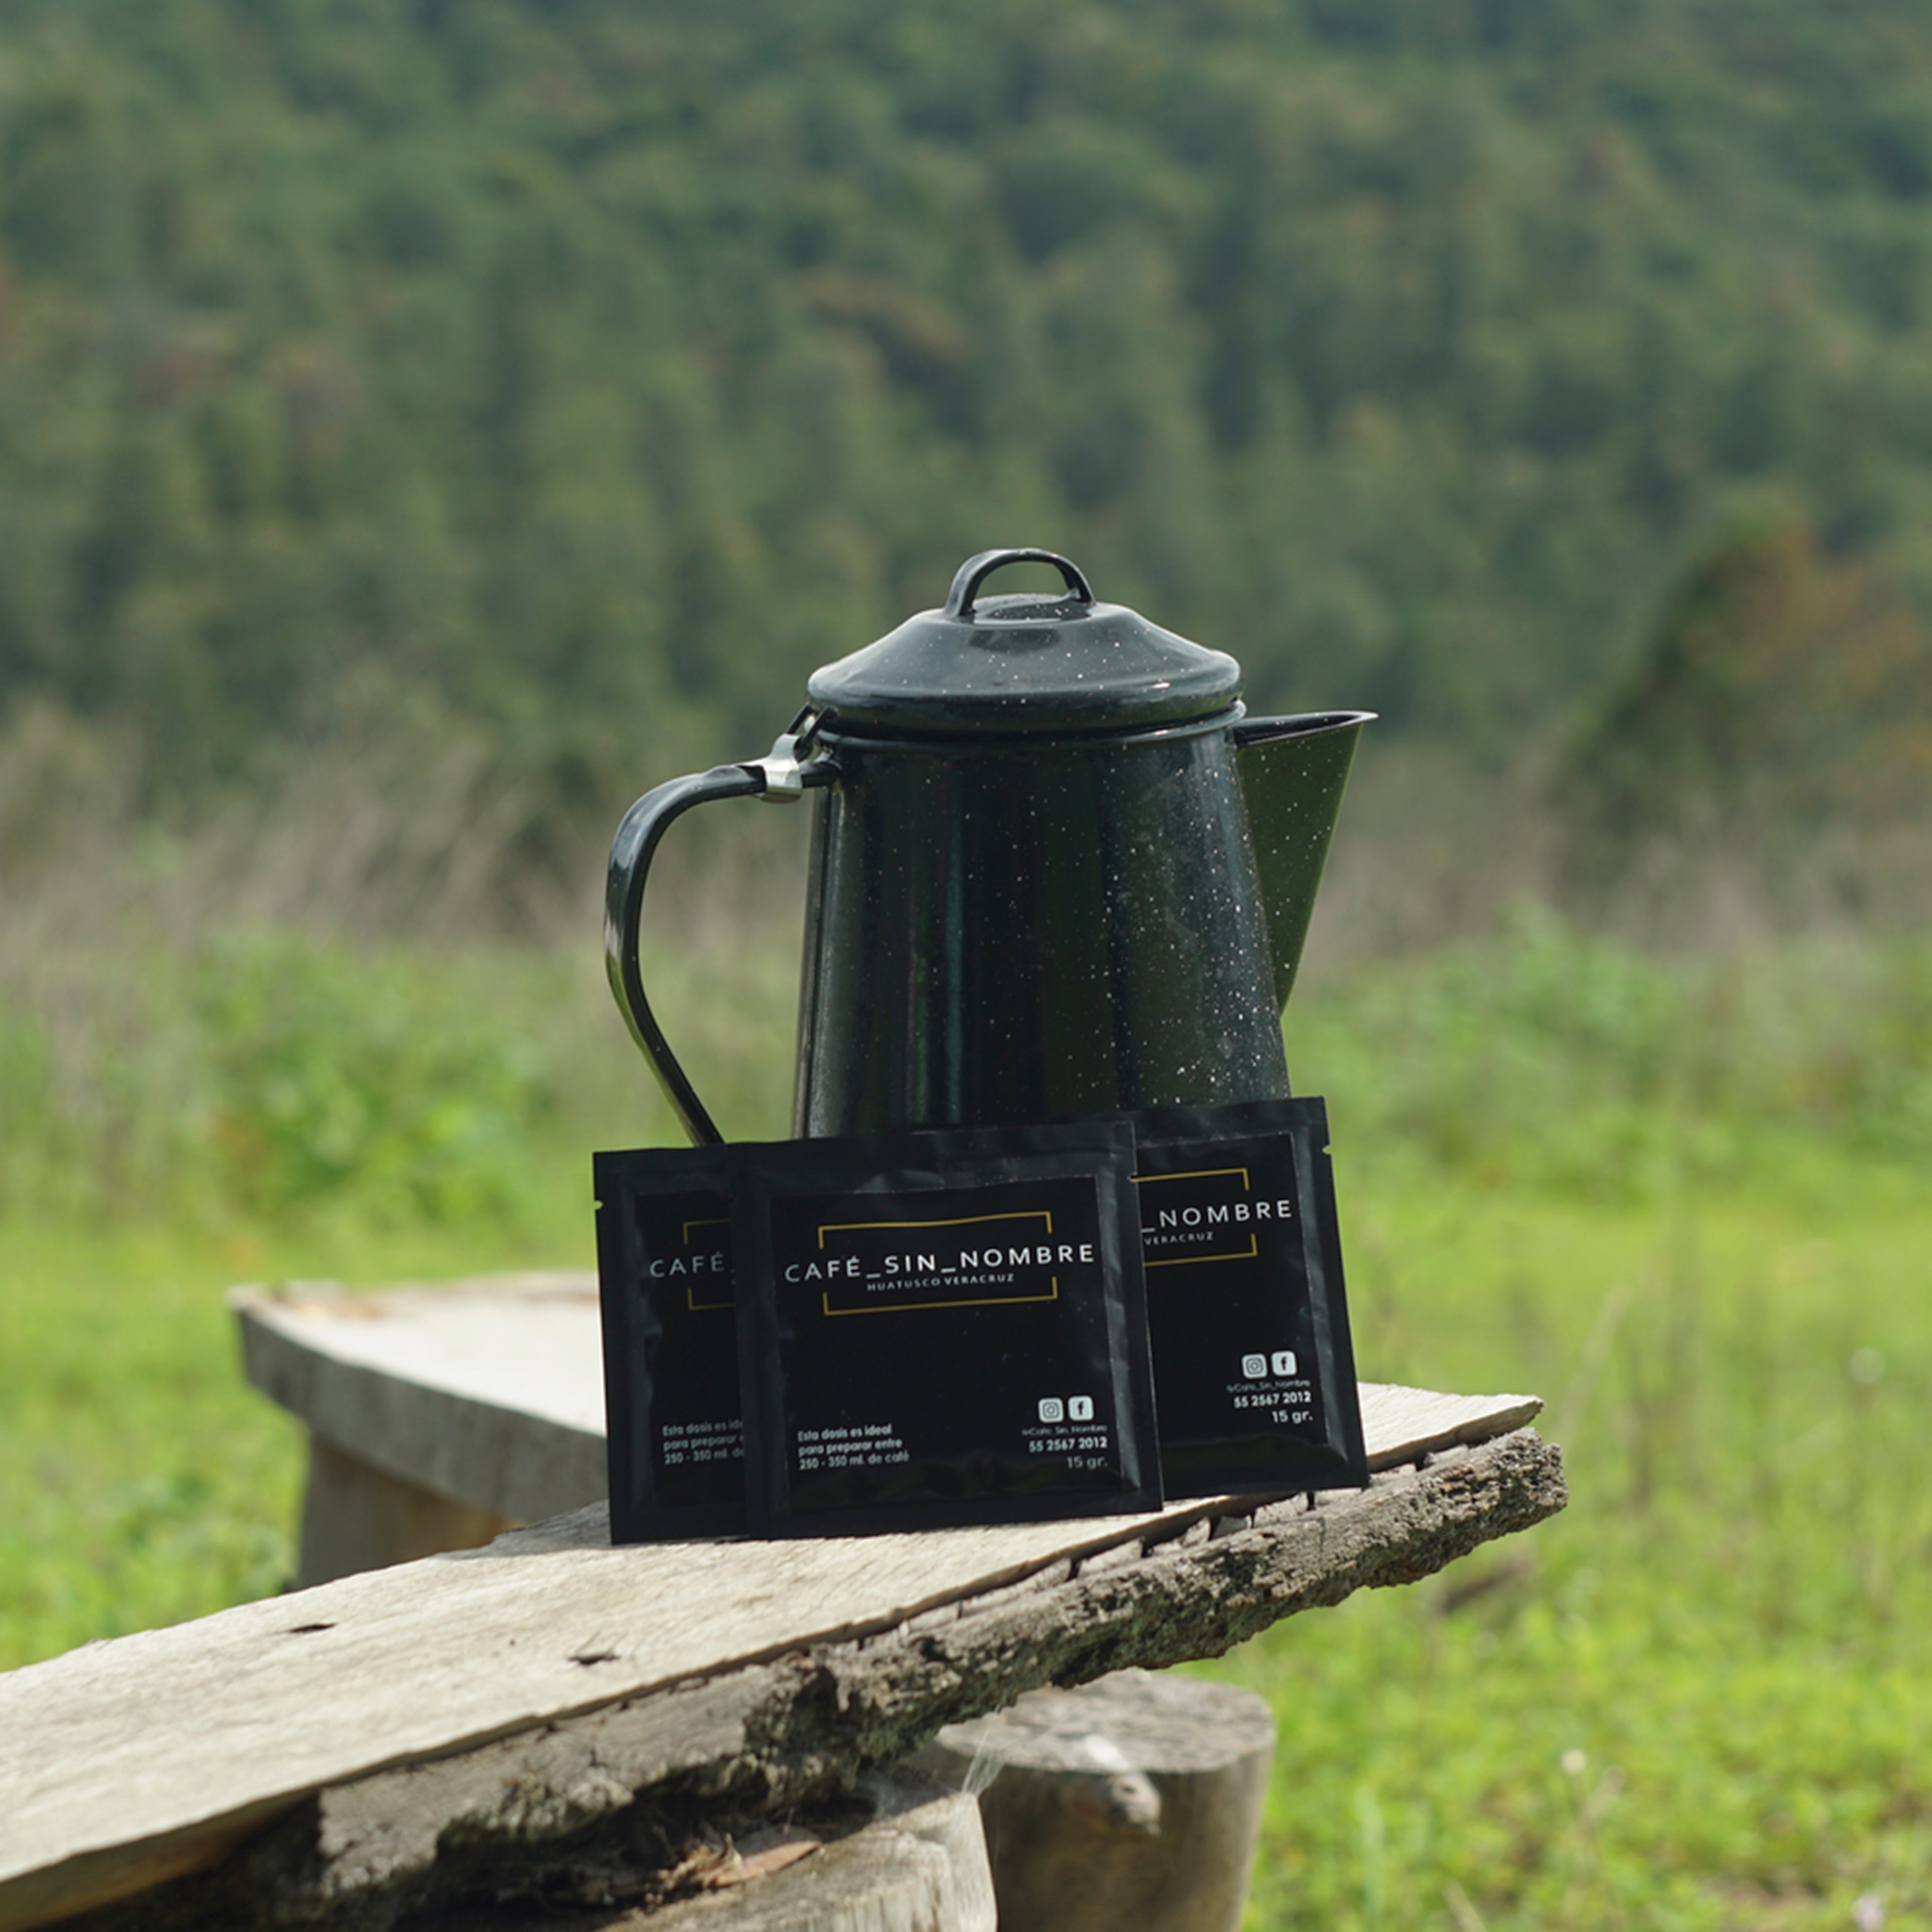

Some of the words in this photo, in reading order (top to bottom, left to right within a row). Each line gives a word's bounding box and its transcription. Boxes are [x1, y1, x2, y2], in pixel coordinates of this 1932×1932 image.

[1144, 1232, 1214, 1245] VERACRUZ
[650, 1251, 735, 1278] CAFÉ
[785, 1244, 1094, 1282] CAFÉ_SIN_NOMBRE
[867, 1277, 940, 1291] HUATUSCO
[944, 1273, 1014, 1285] VERACRUZ
[1234, 1396, 1249, 1408] 55
[1251, 1393, 1279, 1407] 2567
[1283, 1390, 1311, 1404] 2012
[1272, 1410, 1288, 1423] 15
[1292, 1411, 1313, 1424] gr.
[850, 1428, 862, 1437] es
[663, 1439, 689, 1453] para
[799, 1445, 825, 1457] para
[826, 1441, 872, 1455] preparar
[875, 1438, 903, 1449] entre
[1029, 1440, 1044, 1453] 55
[1046, 1438, 1075, 1452] 2567
[1078, 1436, 1108, 1450] 2012
[799, 1458, 820, 1470] 250
[1067, 1456, 1083, 1469] 15
[1087, 1457, 1108, 1471] gr.
